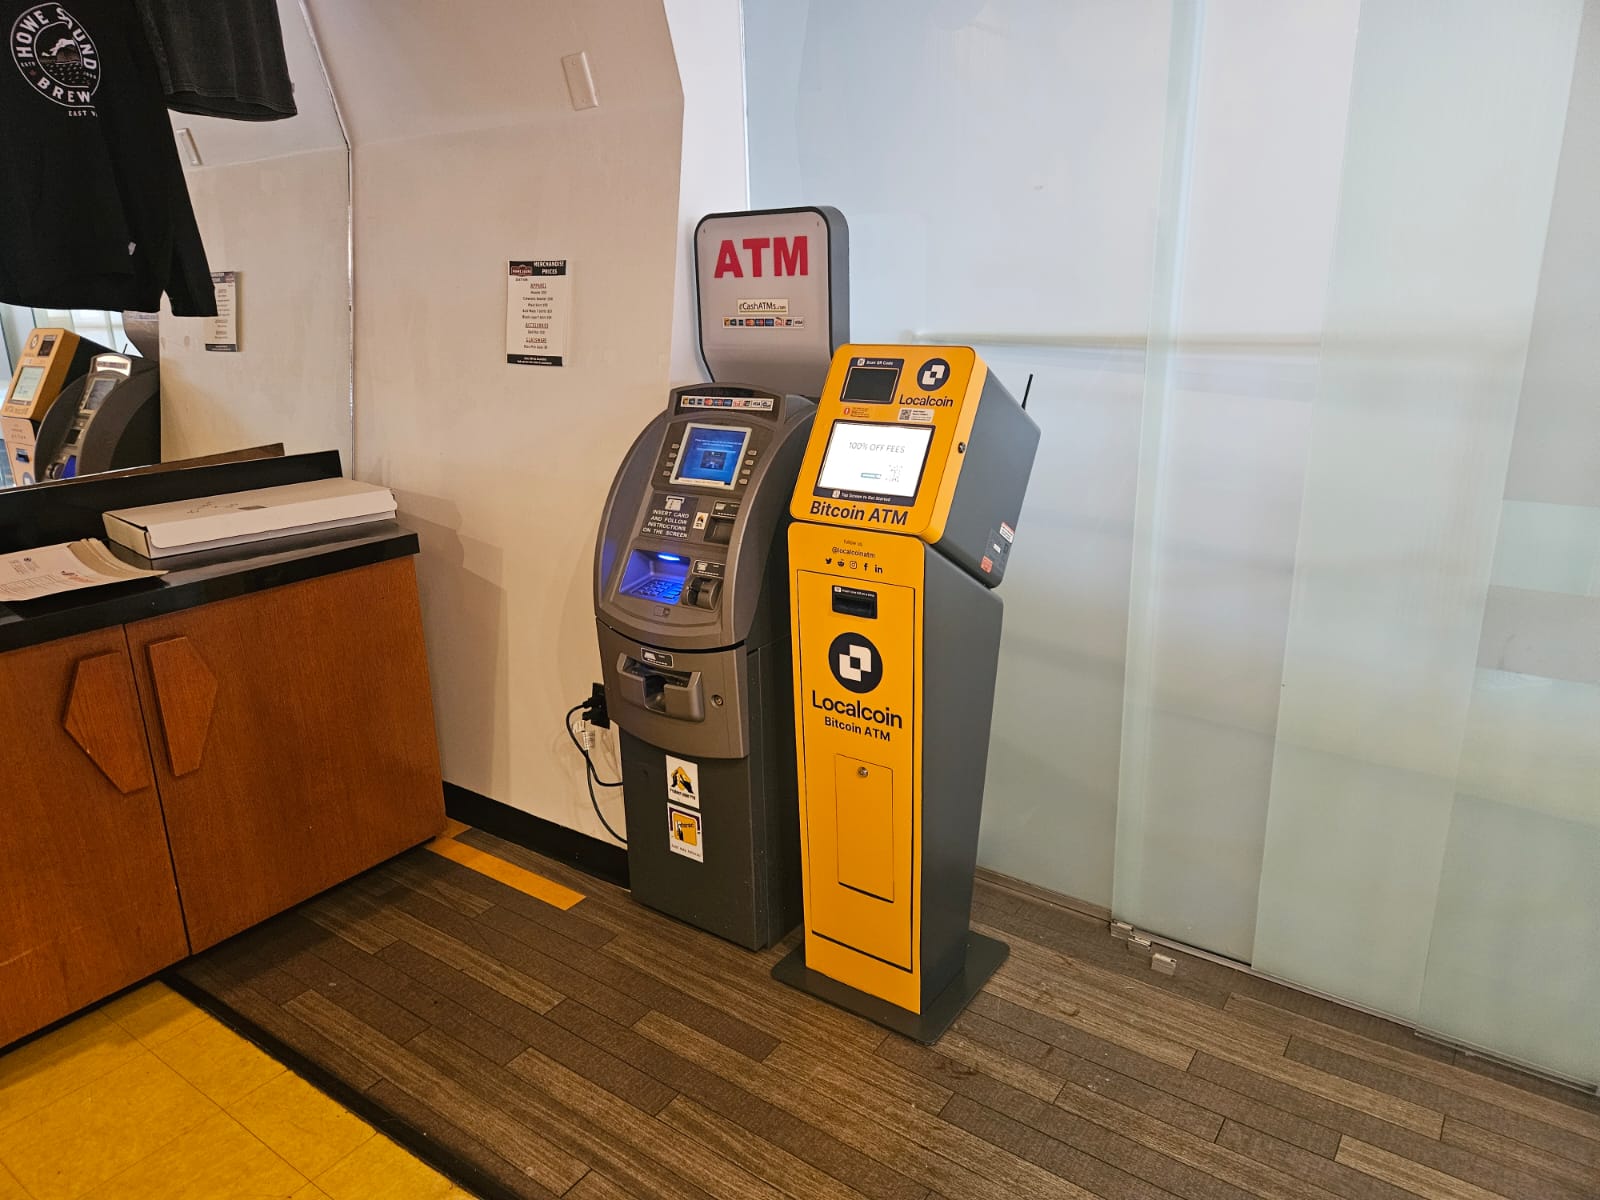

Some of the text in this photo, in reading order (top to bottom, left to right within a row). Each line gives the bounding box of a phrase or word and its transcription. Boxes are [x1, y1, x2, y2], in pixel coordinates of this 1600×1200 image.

[16, 10, 49, 58] HOWE
[714, 235, 808, 278] ATM
[899, 394, 954, 408] Localcoin
[849, 441, 905, 454] 100% OFF FEES
[810, 500, 909, 526] Bitcoin ATM
[665, 530, 688, 538] SCREEN
[812, 689, 903, 729] Localcoin
[824, 716, 891, 742] Bitcoin ATM
